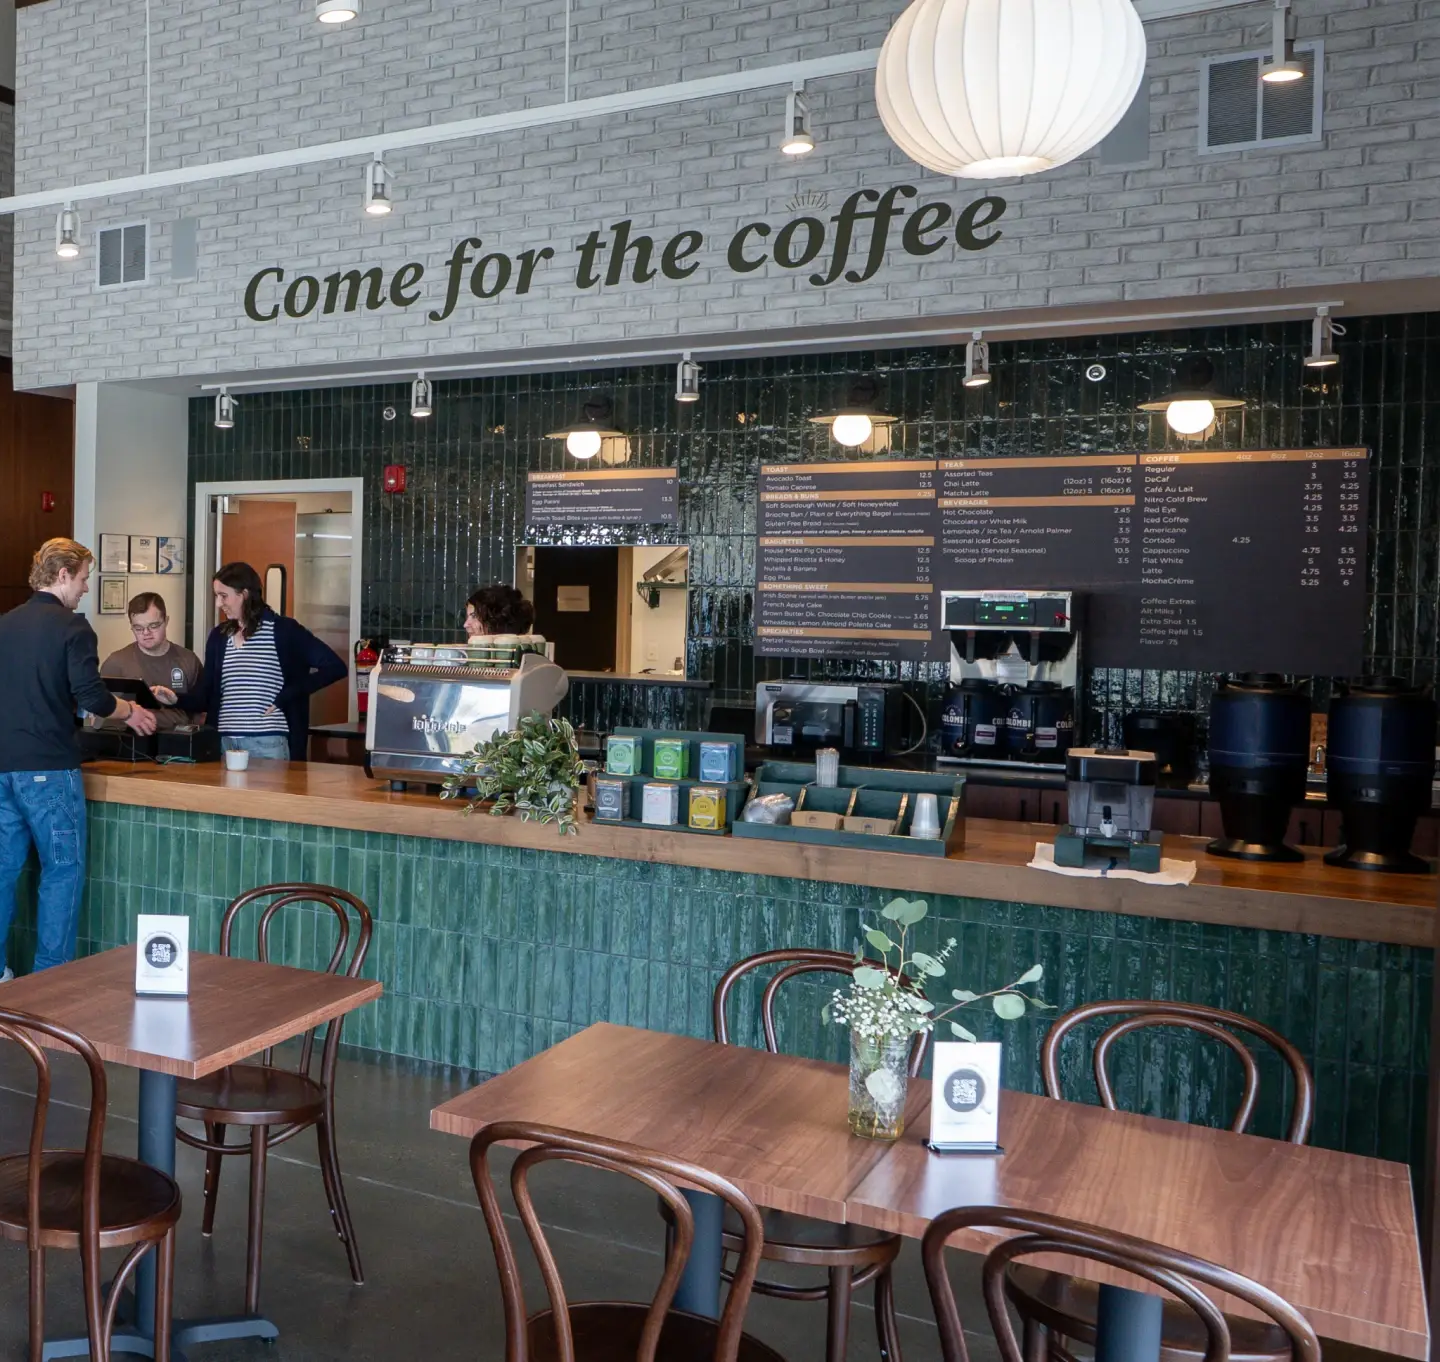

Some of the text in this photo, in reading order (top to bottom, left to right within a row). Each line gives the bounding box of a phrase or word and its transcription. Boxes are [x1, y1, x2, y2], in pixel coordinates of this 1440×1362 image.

[244, 184, 1007, 322] Come for the coffee
